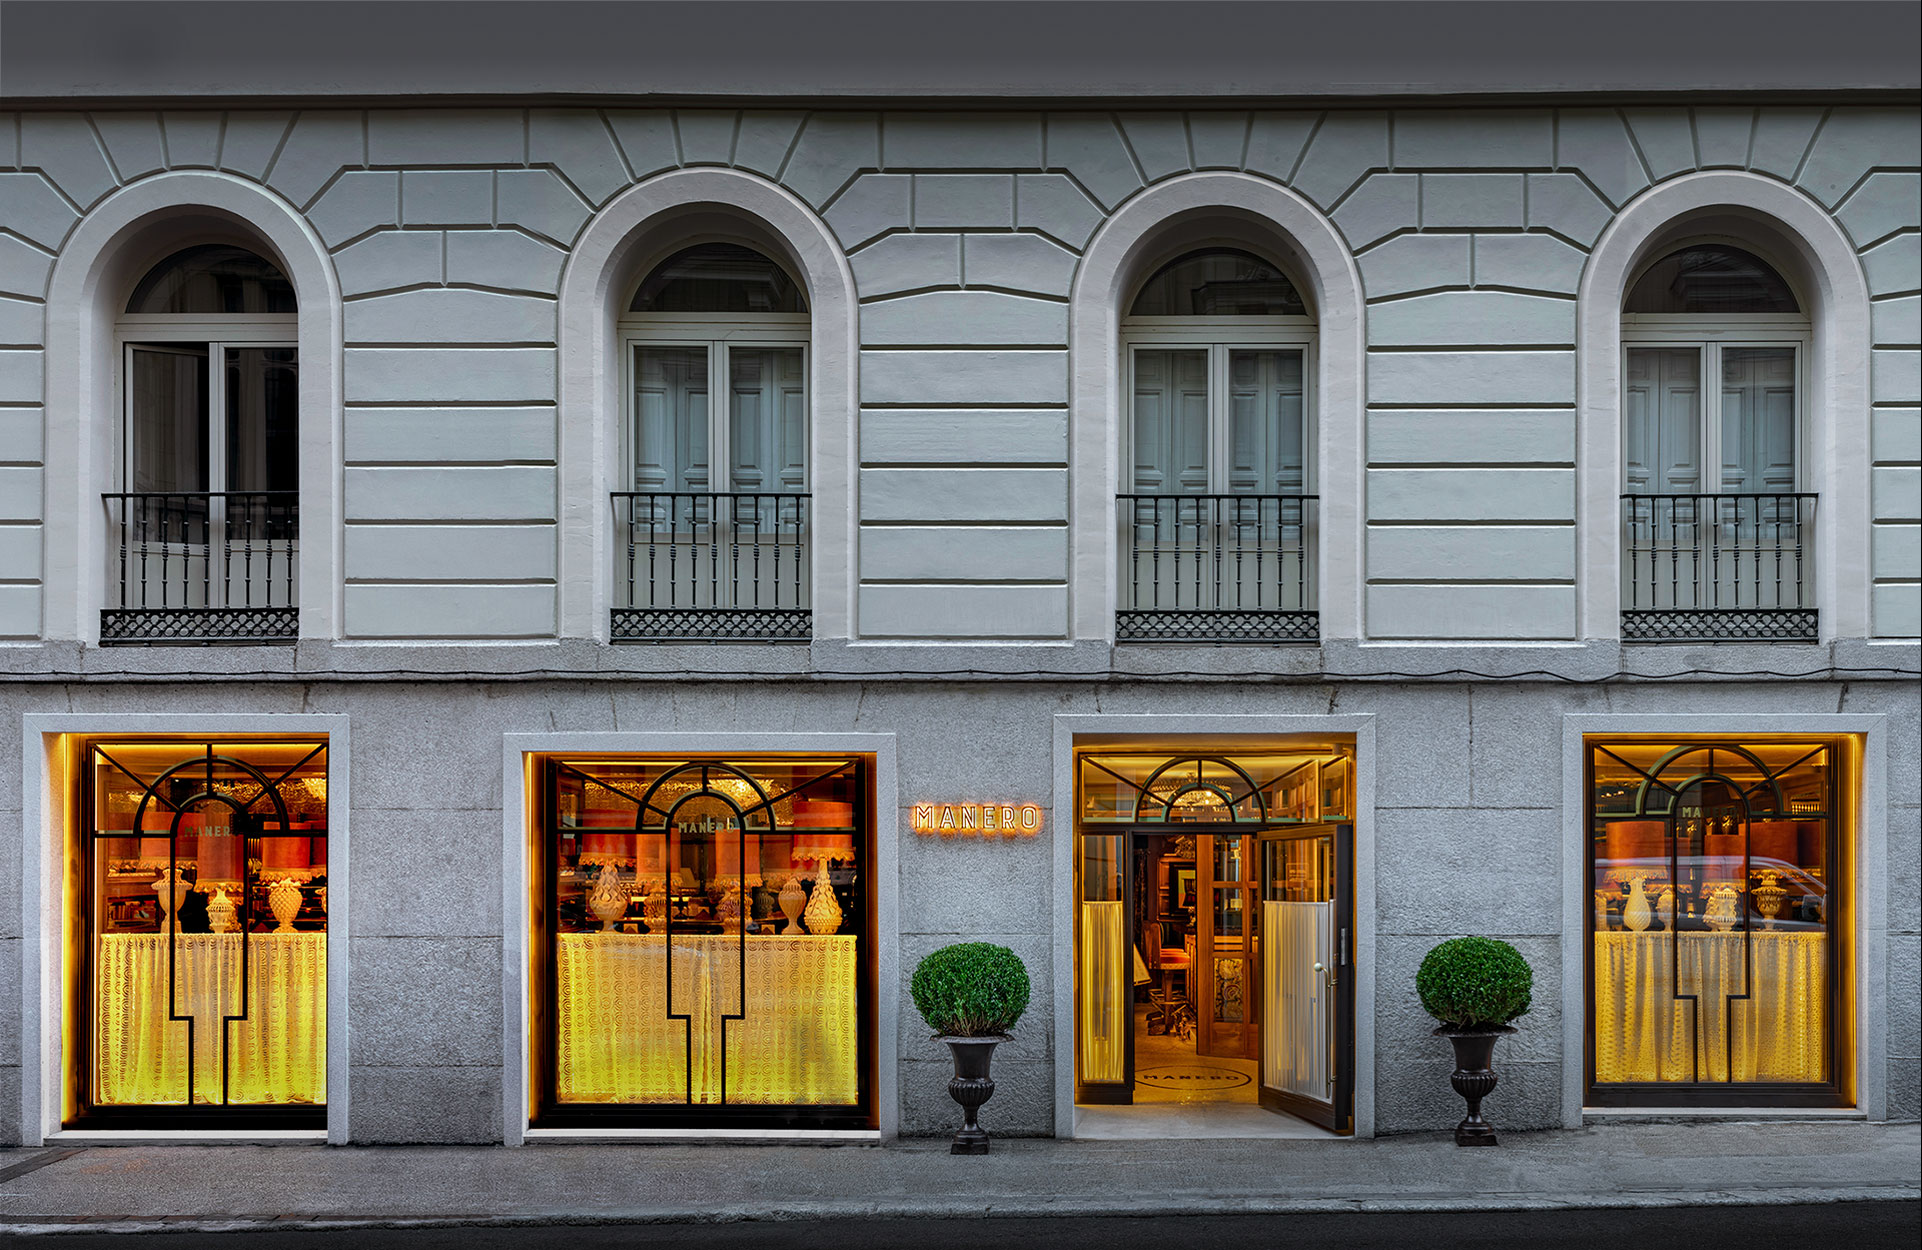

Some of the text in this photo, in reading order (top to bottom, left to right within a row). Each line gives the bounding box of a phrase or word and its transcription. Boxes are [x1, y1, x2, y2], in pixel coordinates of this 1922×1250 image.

[914, 805, 1037, 829] MANERO
[184, 825, 231, 838] MANER
[678, 822, 735, 833] MANERO
